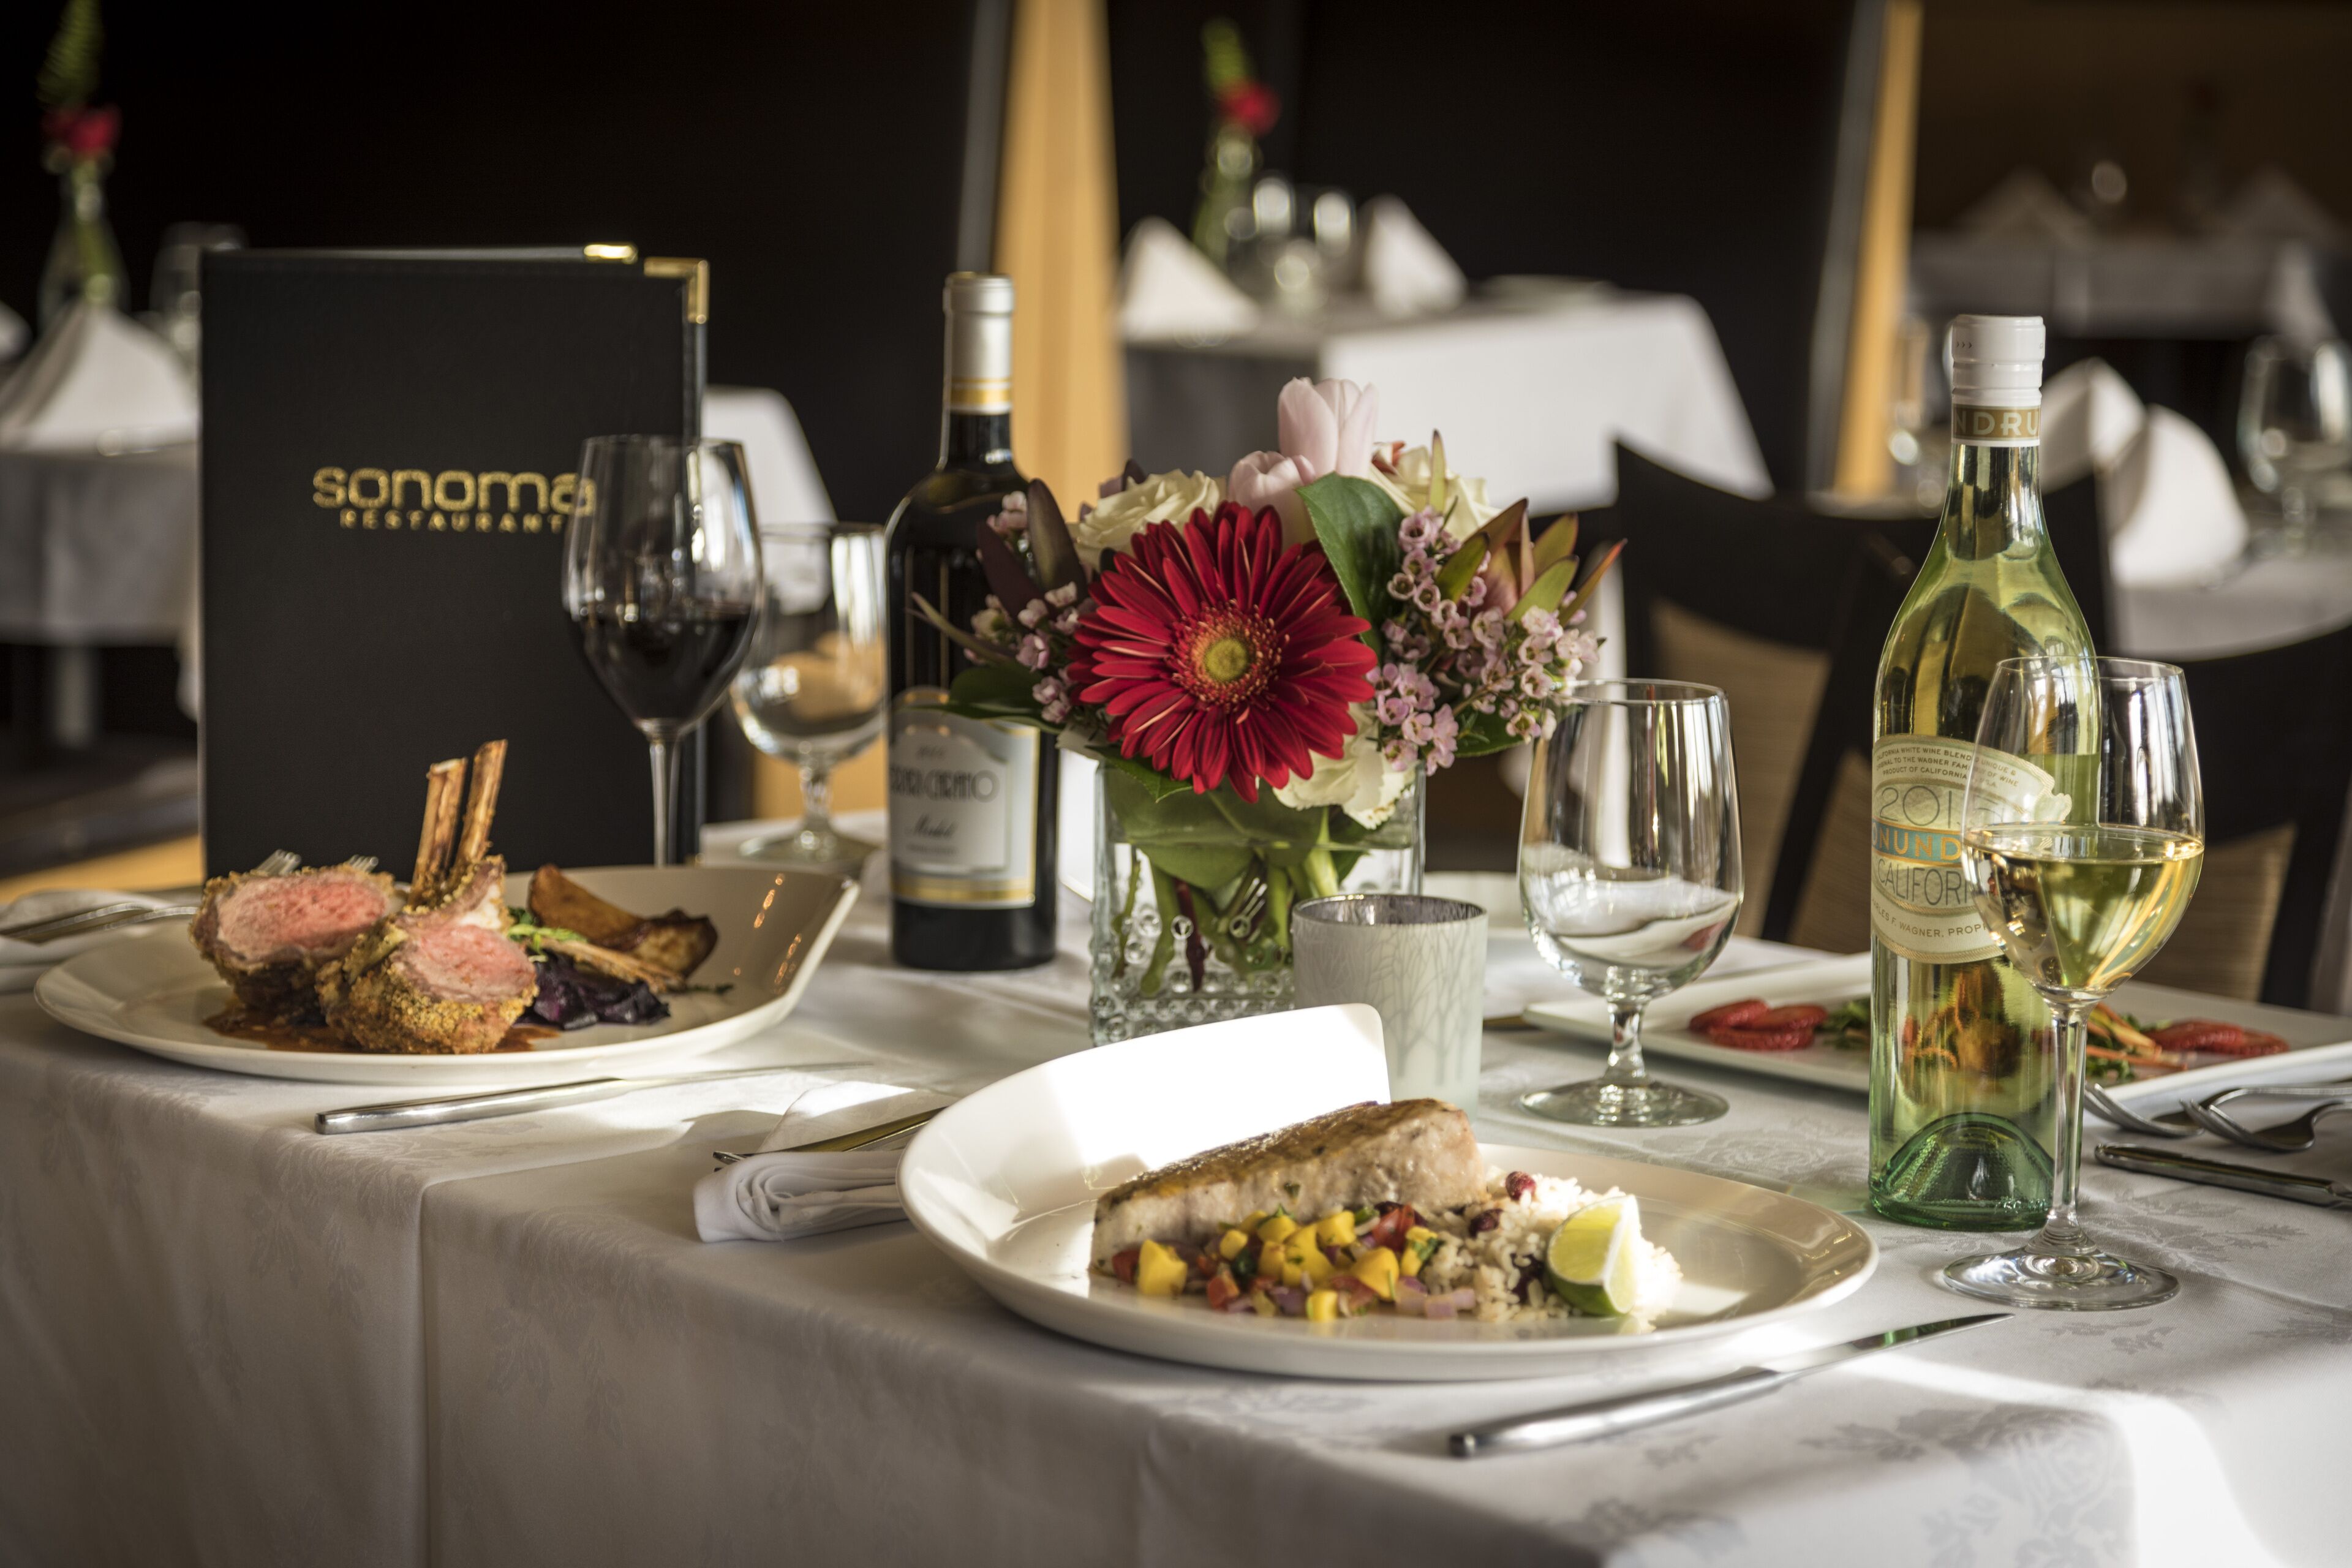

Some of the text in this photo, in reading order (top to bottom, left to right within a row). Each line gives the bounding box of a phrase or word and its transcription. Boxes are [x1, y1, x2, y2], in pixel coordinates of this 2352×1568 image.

[312, 466, 597, 517] sonoma
[339, 508, 565, 533] RESTAURANT
[1877, 747, 1899, 761] CALIFORNIA
[1981, 759, 2010, 774] UNIQUE
[1883, 766, 1907, 776] PRODUCT
[1920, 767, 1967, 780] CALIFORNIA
[1917, 757, 1950, 766] WAGNER
[1999, 775, 2019, 787] WINE
[1877, 858, 1968, 906] CALIFOR
